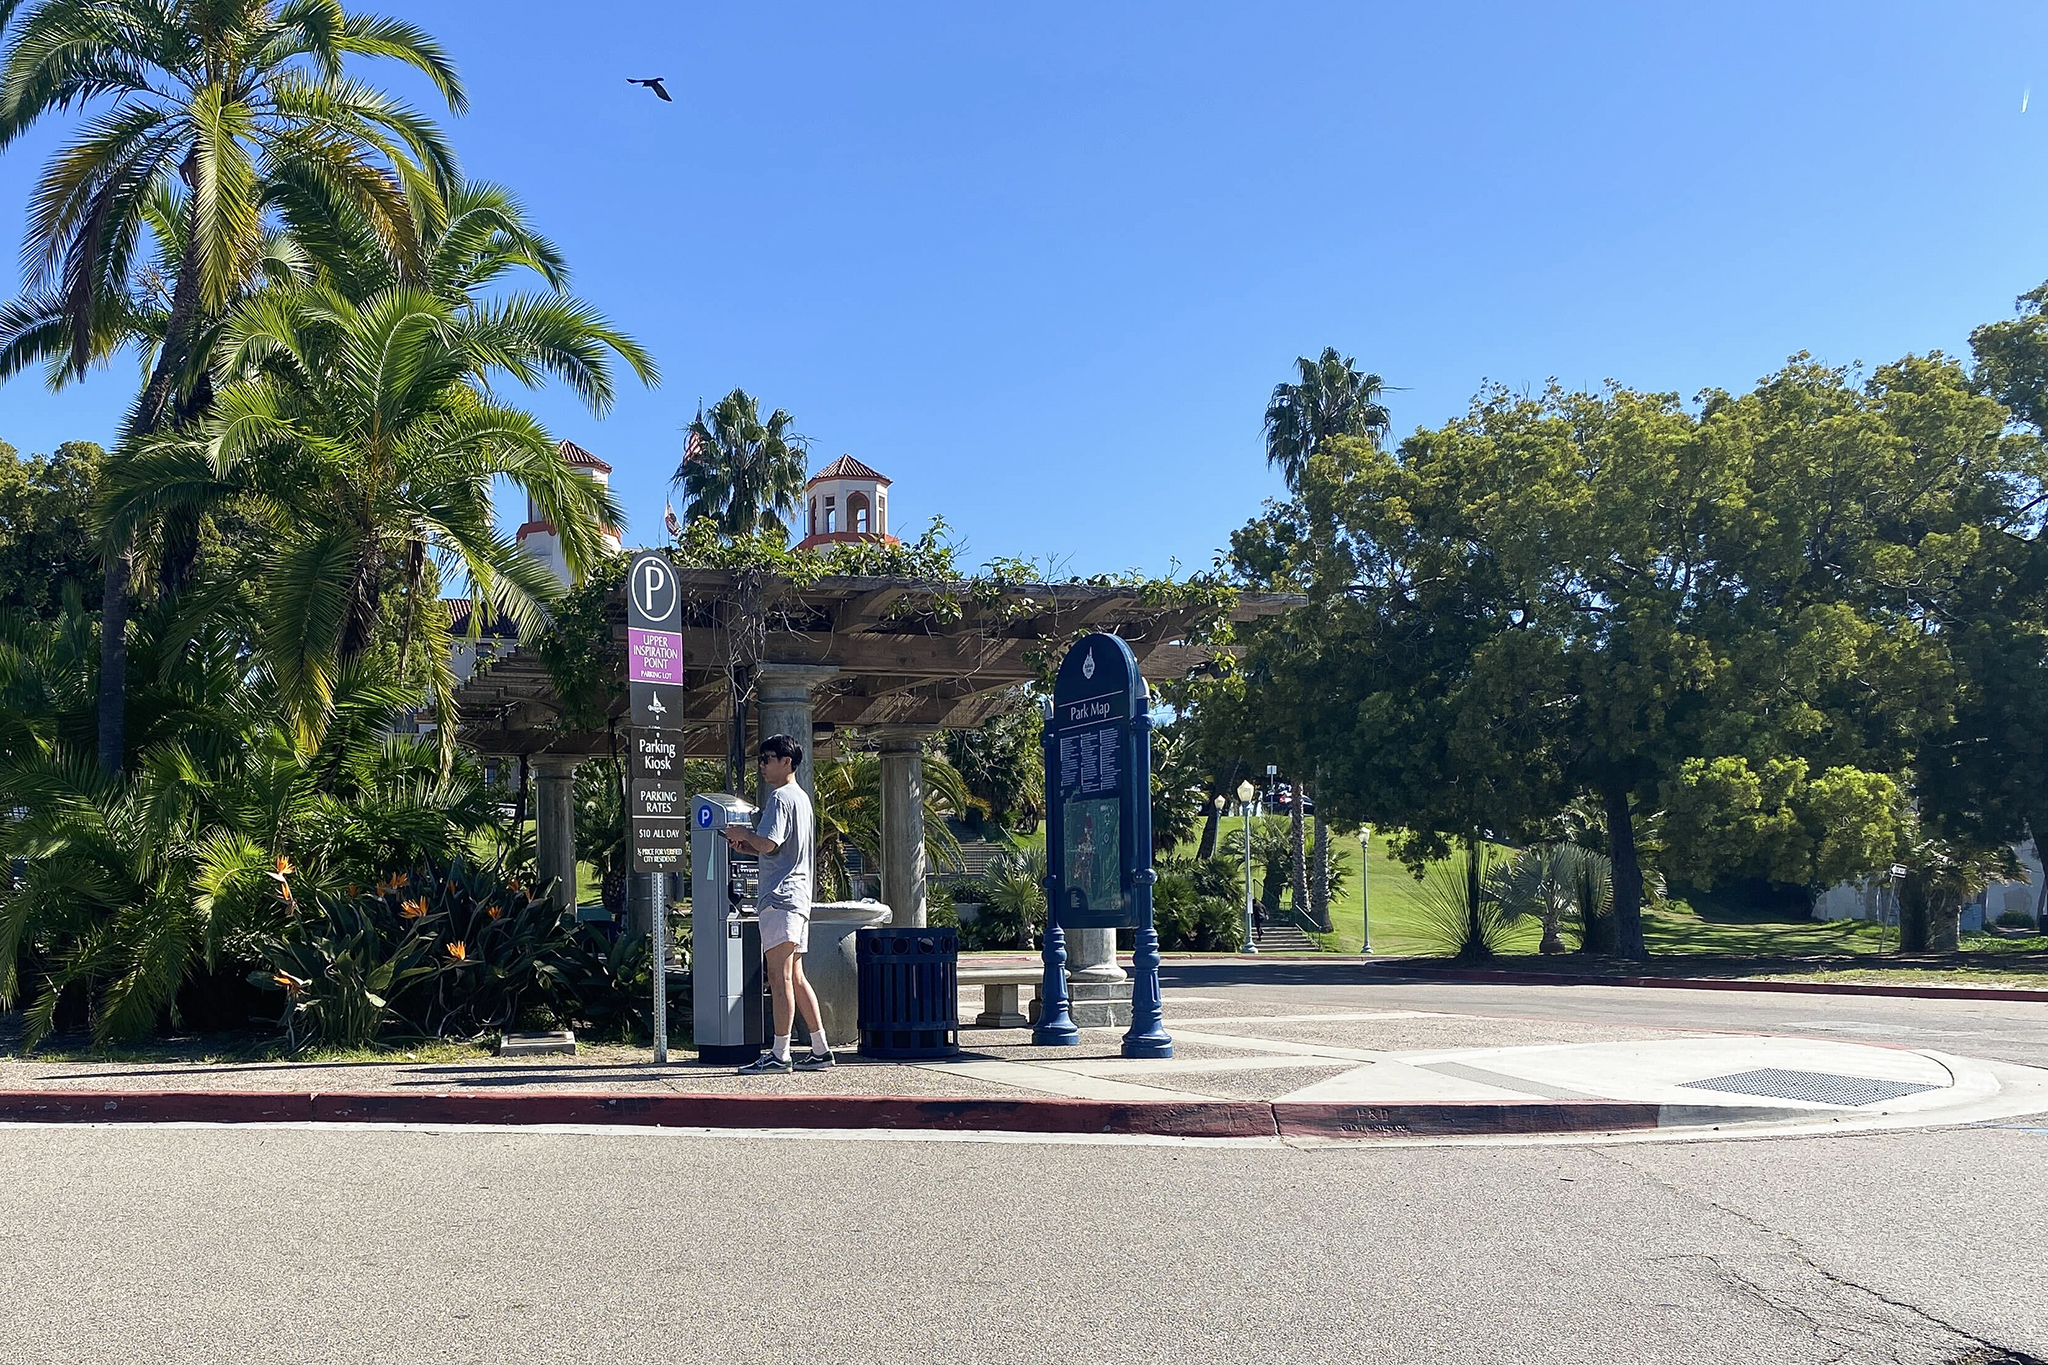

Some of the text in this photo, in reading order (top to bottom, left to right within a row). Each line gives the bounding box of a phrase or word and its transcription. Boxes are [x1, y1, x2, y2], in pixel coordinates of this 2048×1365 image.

[645, 565, 665, 611] P
[643, 634, 668, 647] UPPER
[633, 644, 678, 659] INSPIRATION
[644, 657, 668, 669] POINT
[641, 670, 661, 679] PARKING
[1070, 701, 1110, 721] Park Map
[639, 738, 676, 759] Parking
[645, 755, 671, 770] Kiosk
[640, 790, 677, 802] PARKING
[646, 802, 672, 813] RATES
[701, 808, 710, 824] P
[638, 828, 680, 839] $10 ALL DAY
[642, 848, 655, 856] PRICE
[655, 848, 664, 856] FOR
[664, 848, 683, 856] VERIFIED
[643, 855, 677, 863] CITY RESIDENTS
